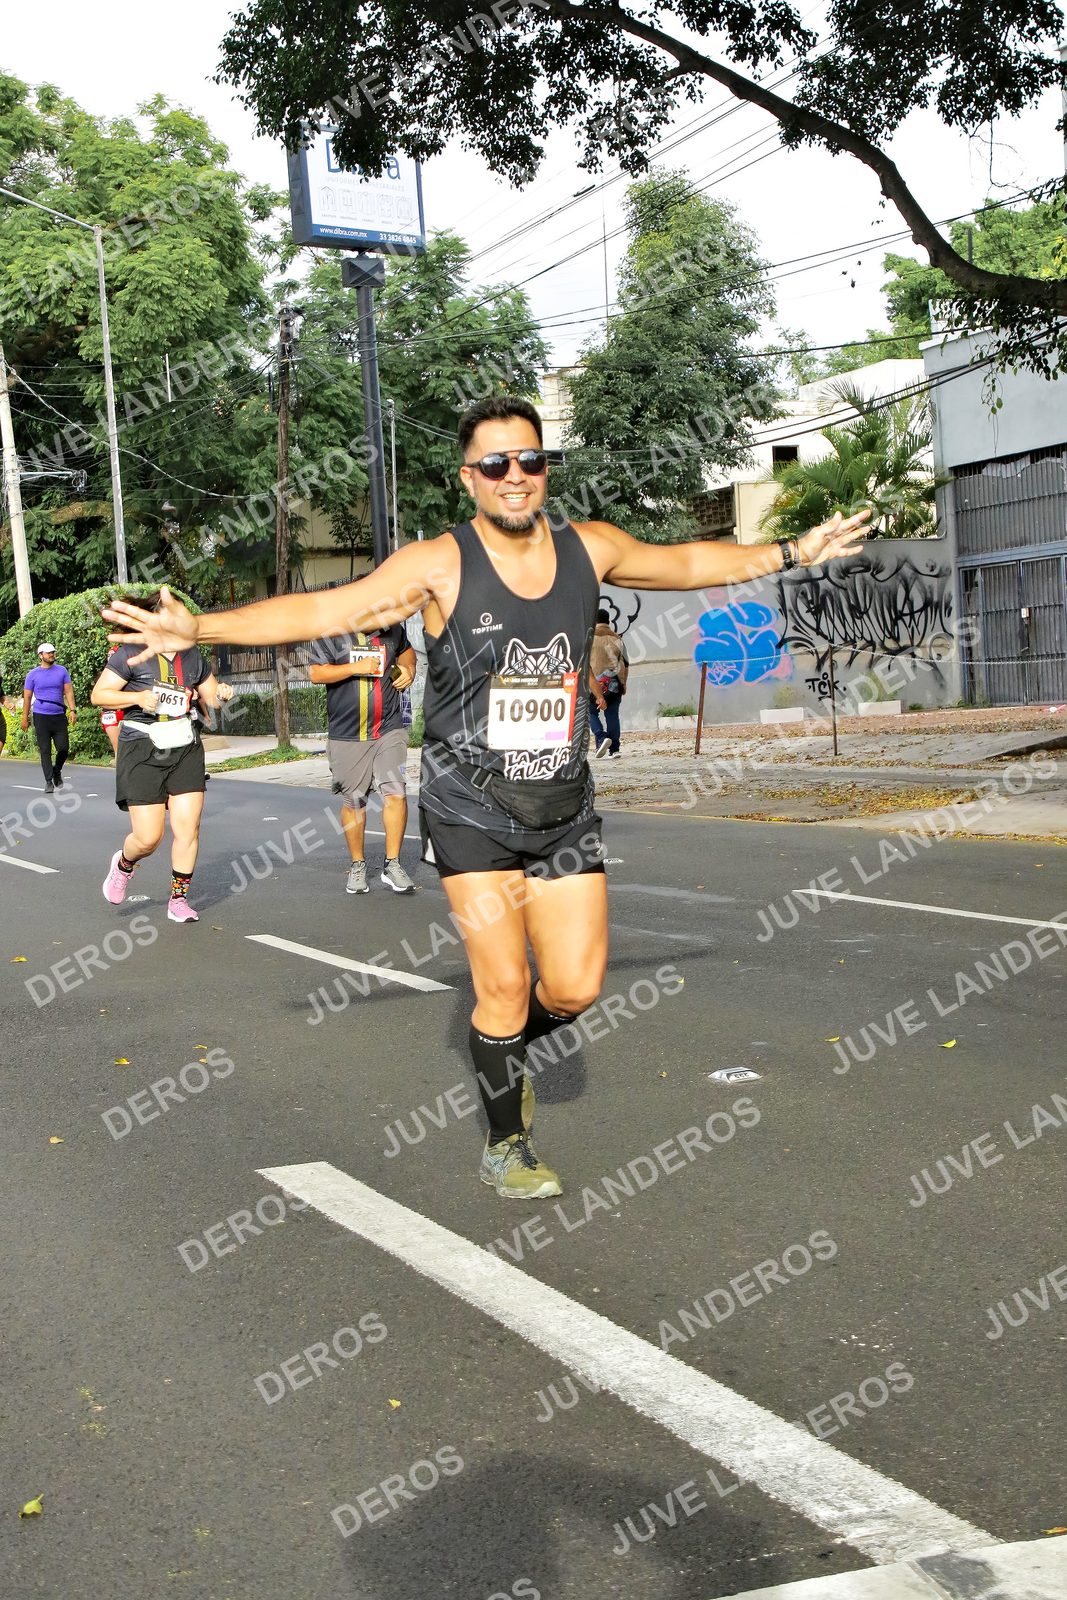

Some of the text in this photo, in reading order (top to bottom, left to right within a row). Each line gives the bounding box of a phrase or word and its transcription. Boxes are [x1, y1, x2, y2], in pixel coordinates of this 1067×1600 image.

[320, 227, 367, 238] www.dibra.com.mx
[380, 233, 388, 241] 33
[472, 623, 503, 635] TOPTIME
[155, 691, 184, 707] 0651
[496, 698, 565, 722] 10900
[505, 751, 530, 767] LA
